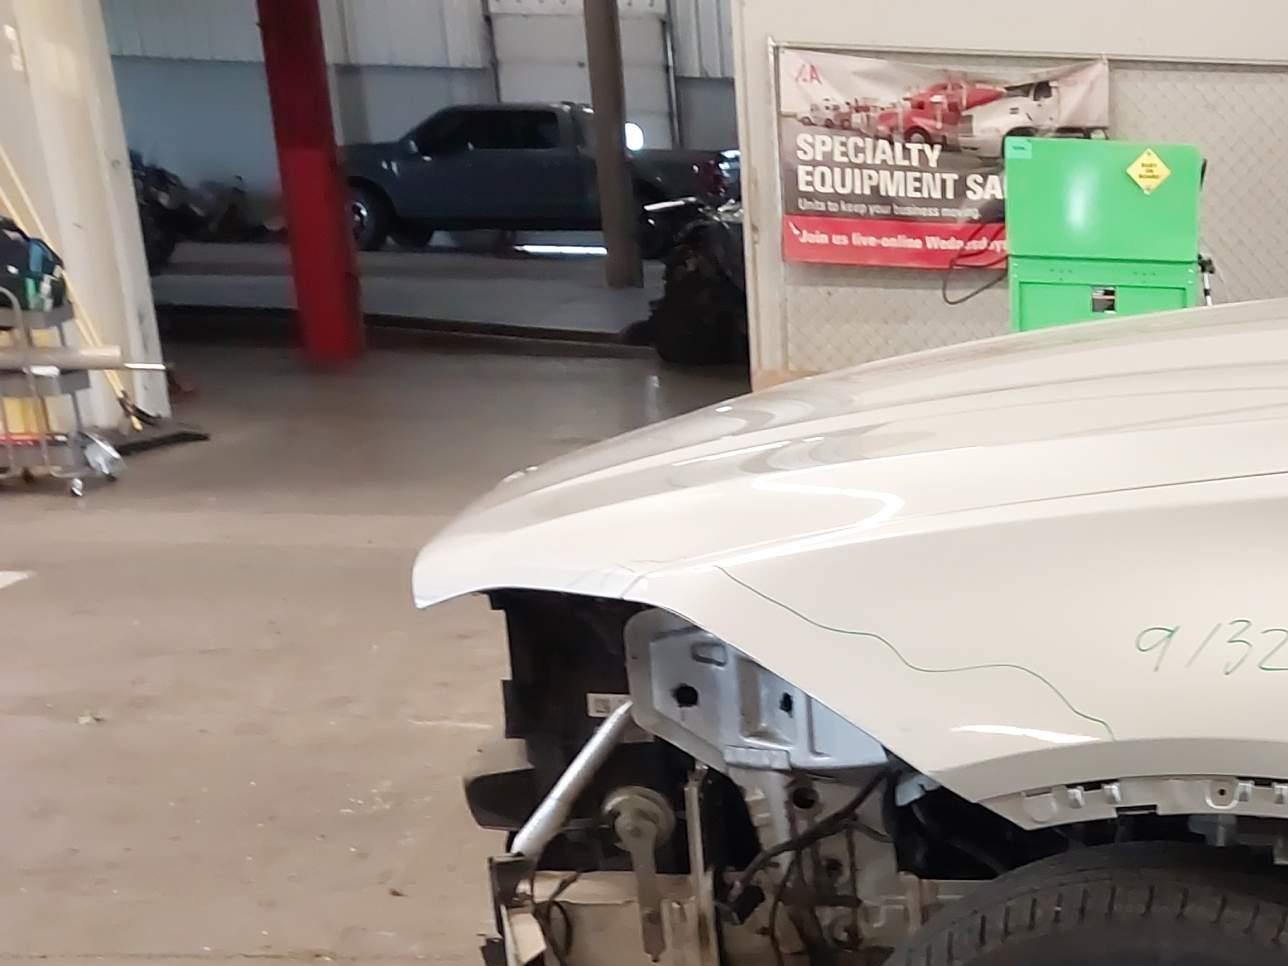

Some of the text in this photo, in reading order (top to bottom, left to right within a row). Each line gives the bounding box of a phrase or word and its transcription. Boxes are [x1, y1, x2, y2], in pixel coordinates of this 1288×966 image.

[796, 133, 942, 169] SPECIALTY
[797, 165, 959, 200] EQUIPMENT
[827, 201, 839, 212] to
[840, 200, 867, 215] keep
[868, 203, 891, 216] your
[892, 203, 940, 217] business
[800, 229, 829, 243] Join
[831, 234, 849, 246] us
[851, 231, 923, 249] live-online
